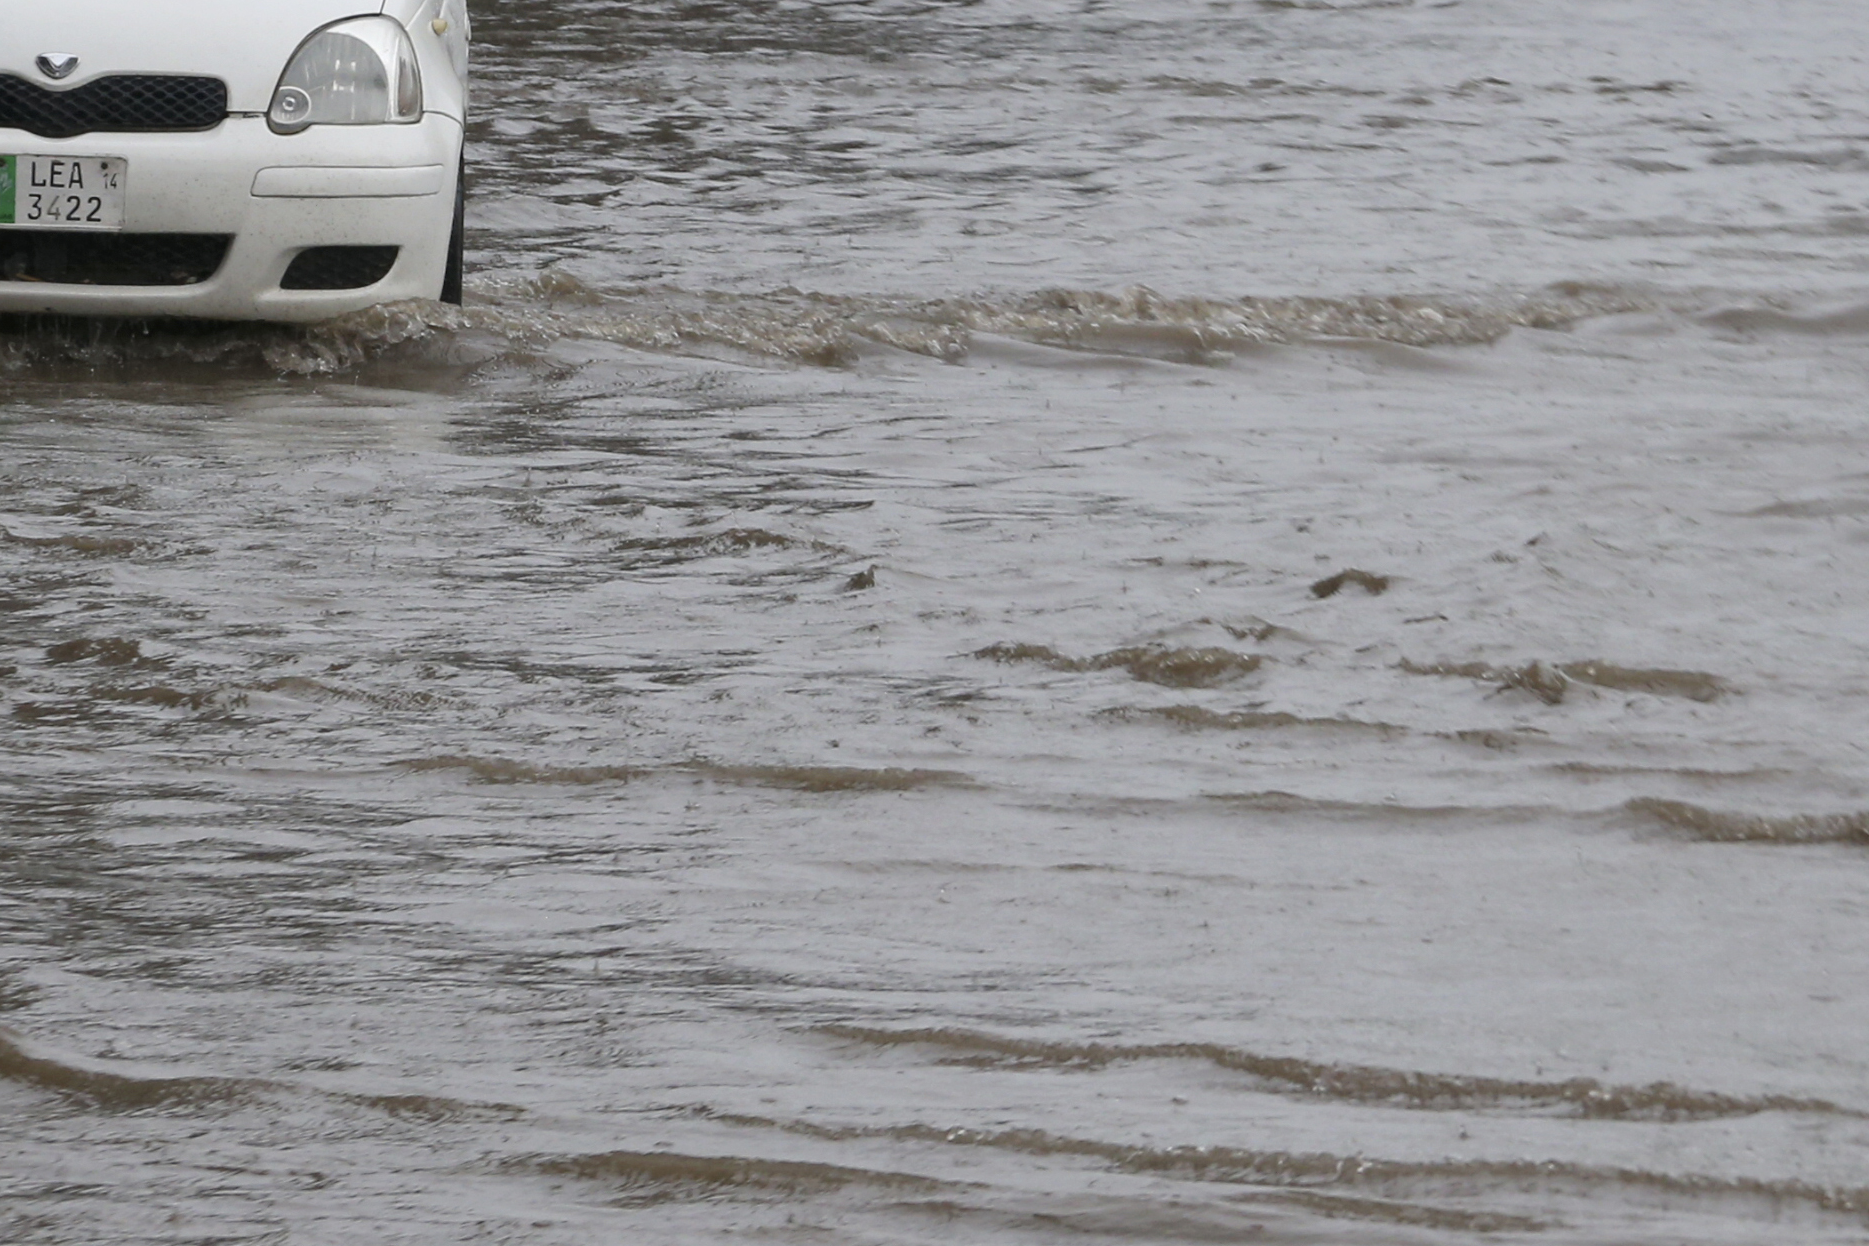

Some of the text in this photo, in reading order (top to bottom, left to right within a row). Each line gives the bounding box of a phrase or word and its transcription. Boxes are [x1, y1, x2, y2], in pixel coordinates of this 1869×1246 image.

[30, 161, 118, 189] LEA 14
[27, 194, 102, 222] 3422
